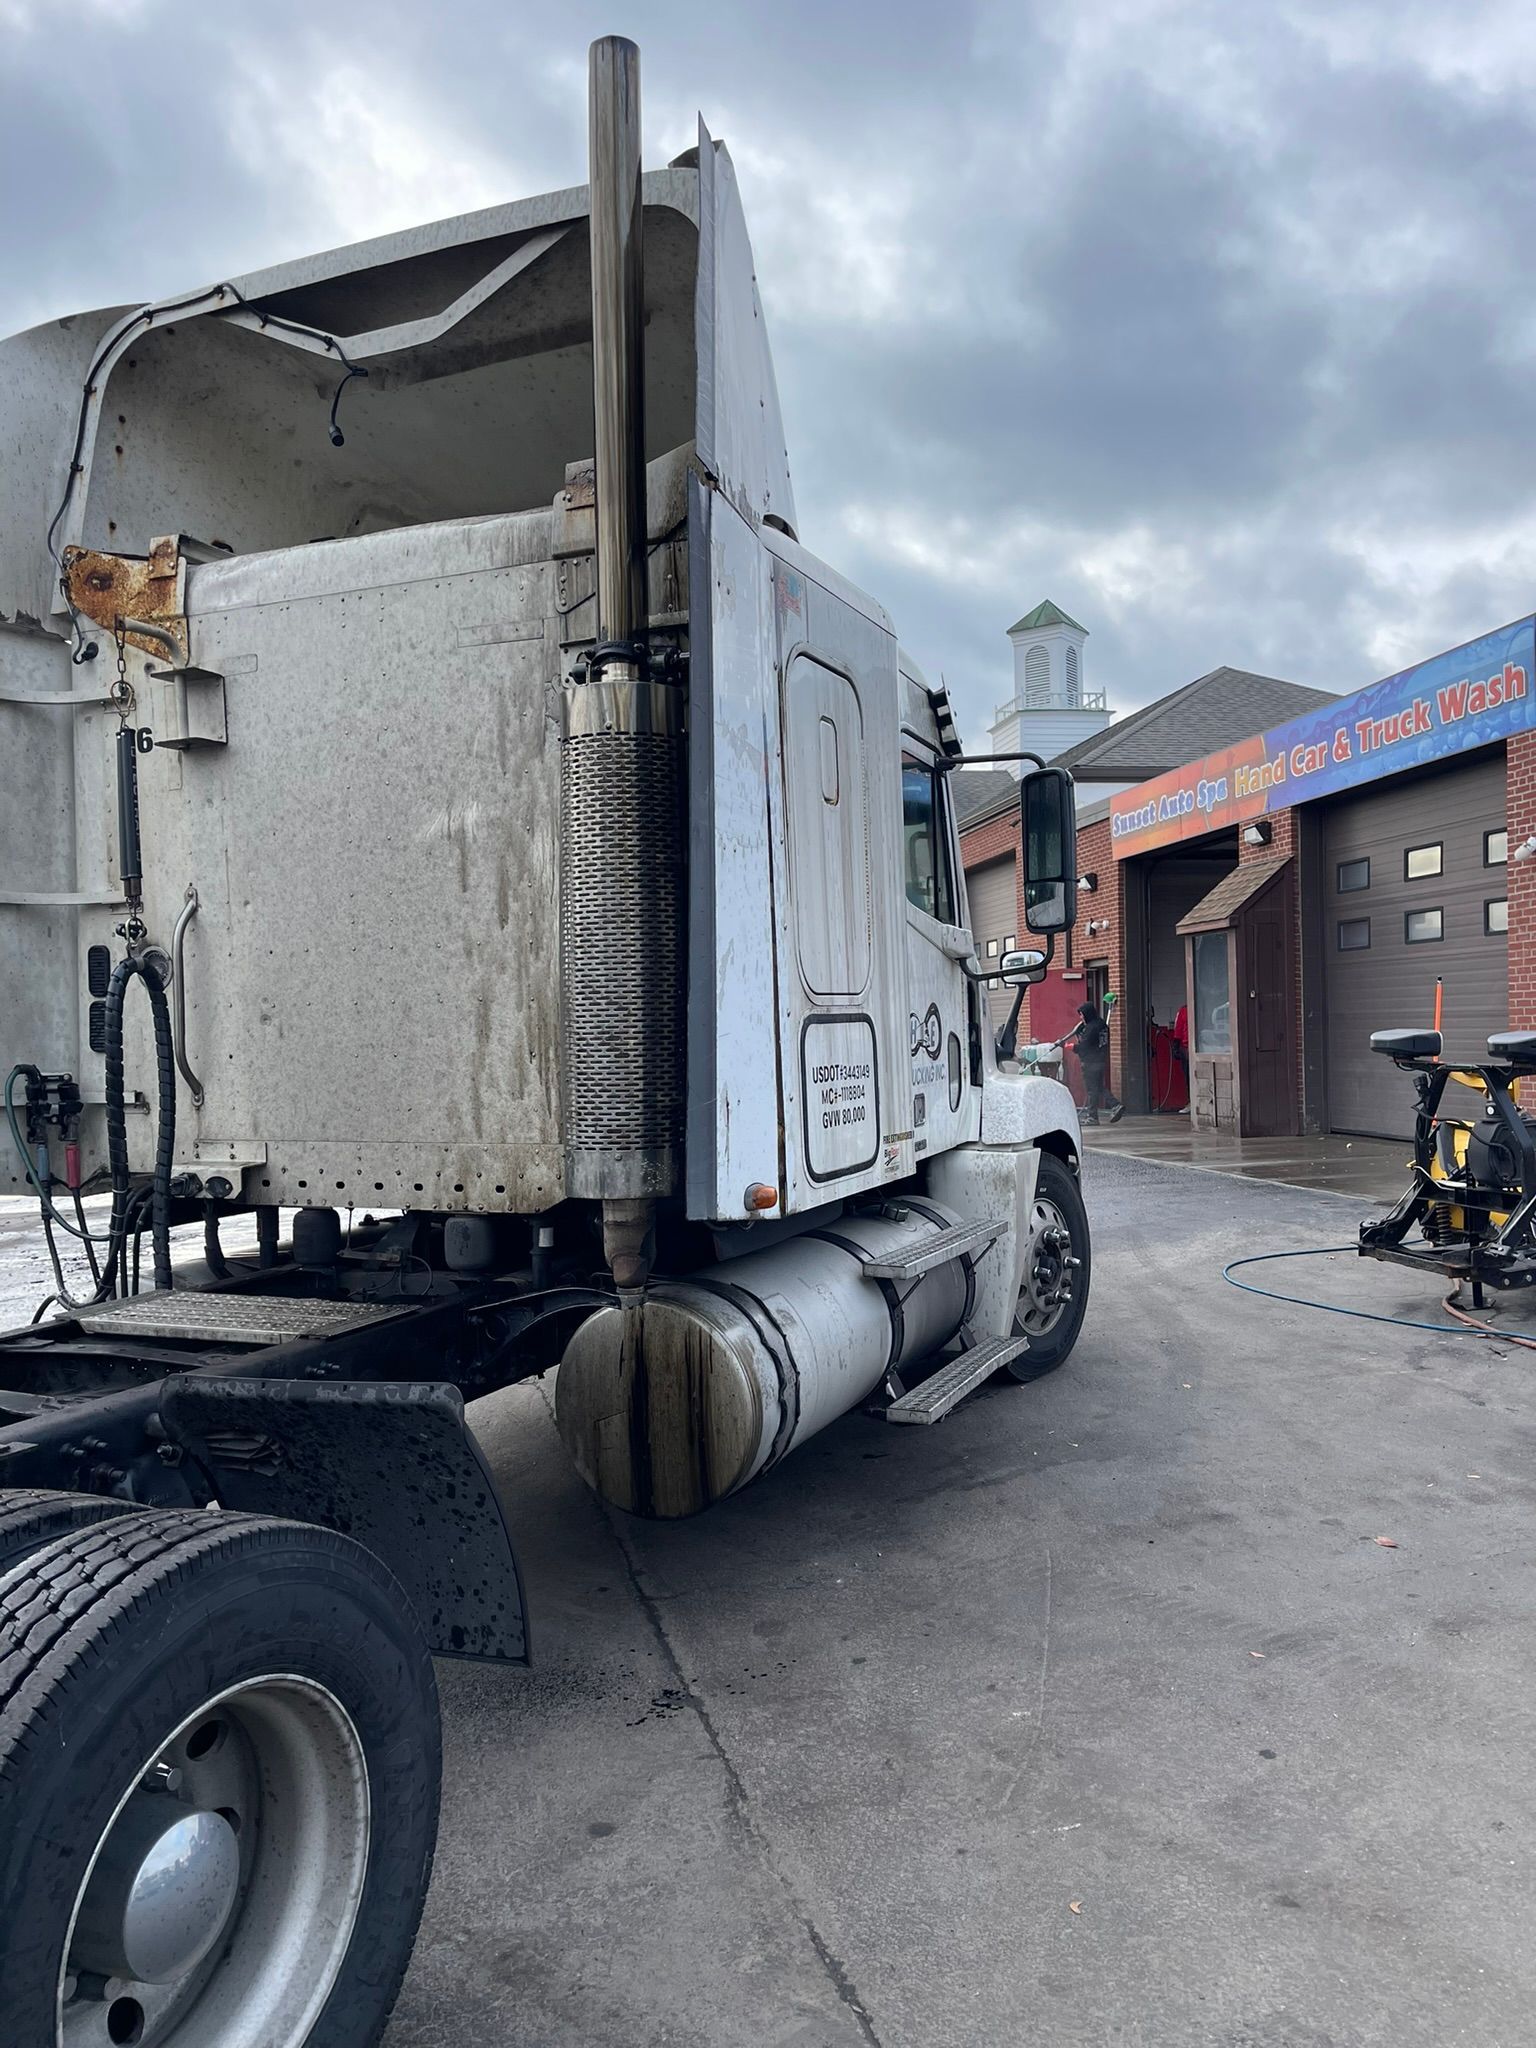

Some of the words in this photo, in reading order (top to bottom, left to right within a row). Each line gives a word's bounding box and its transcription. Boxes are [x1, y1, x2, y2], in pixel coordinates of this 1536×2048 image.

[136, 726, 154, 754] 6
[1111, 801, 1157, 838] Sunset
[1158, 789, 1194, 822] Auto
[1196, 776, 1228, 812] Spa
[1234, 752, 1286, 798] Hand
[1290, 743, 1328, 777] Car
[1332, 727, 1352, 763] &
[1355, 698, 1431, 757] Truck
[1437, 661, 1528, 725] Wash
[911, 1064, 934, 1086] UCKING
[822, 1109, 841, 1129] GVW
[842, 1105, 866, 1125] 80,000
